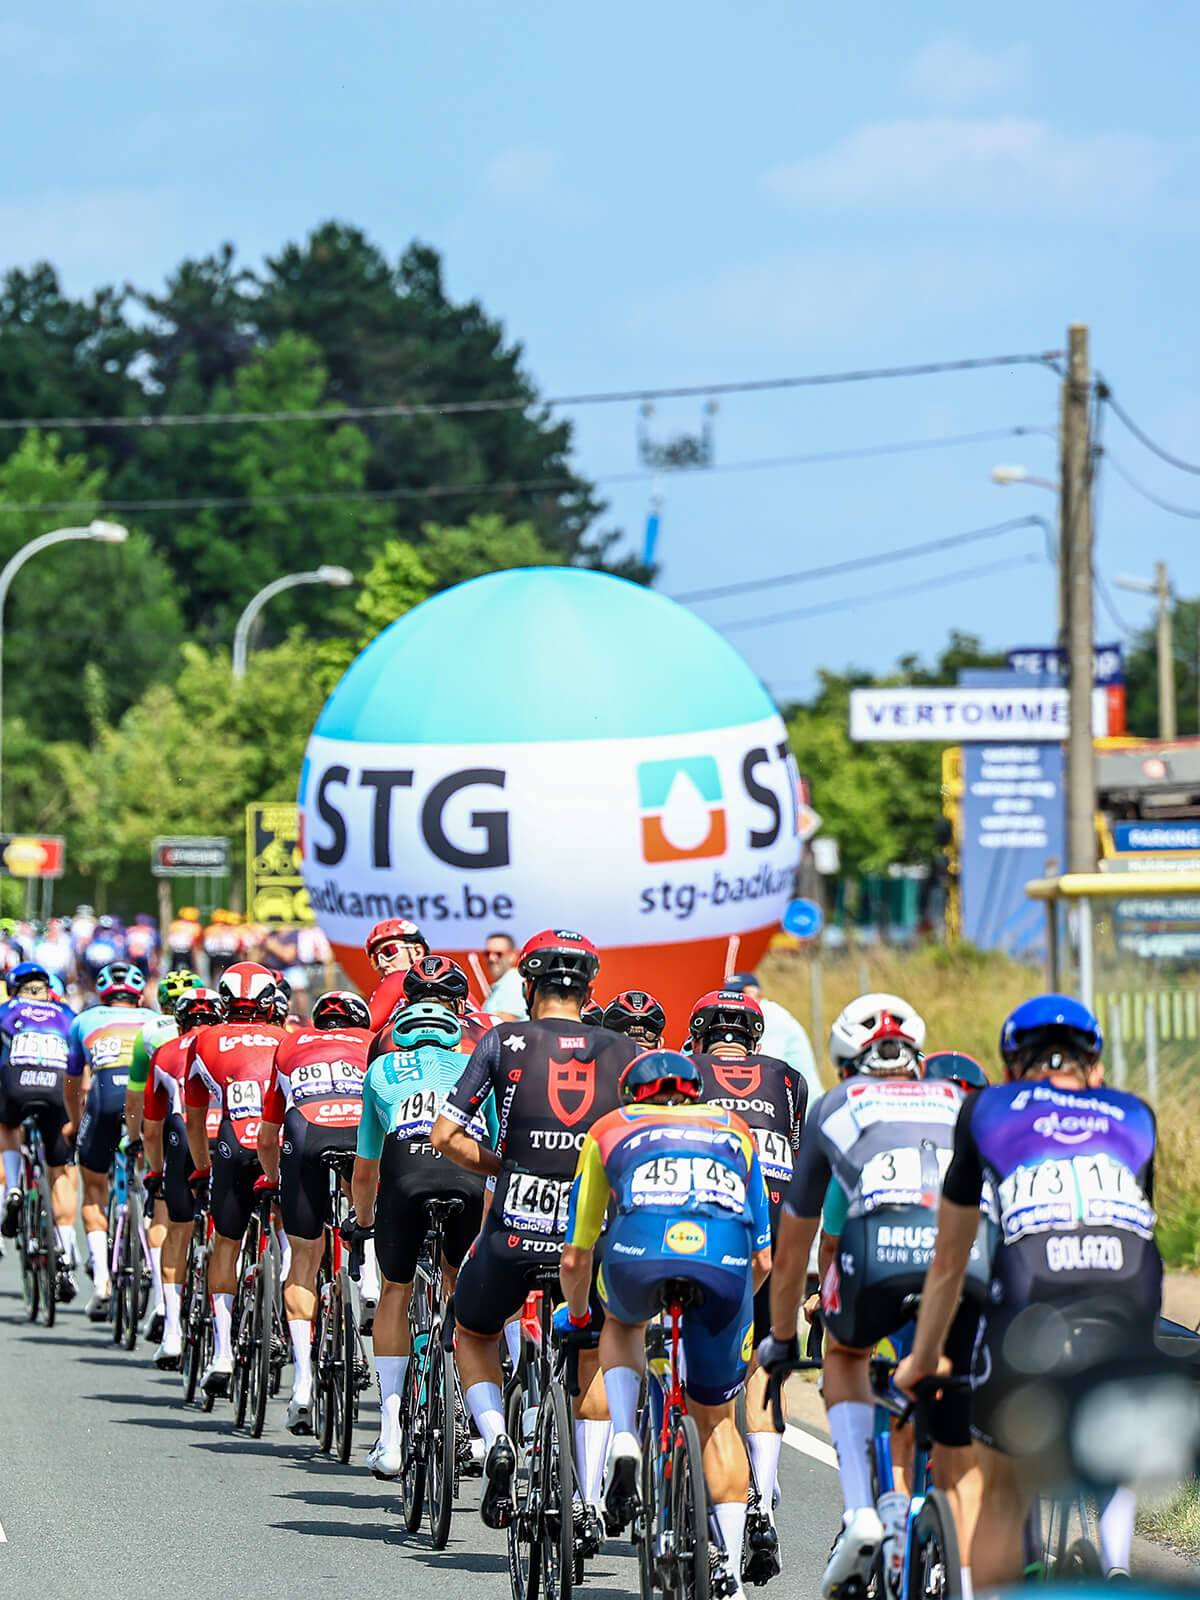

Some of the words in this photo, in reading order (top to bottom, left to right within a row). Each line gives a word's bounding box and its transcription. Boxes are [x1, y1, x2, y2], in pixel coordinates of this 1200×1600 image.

[866, 702, 1067, 726] VERTOMME
[313, 764, 511, 869] STG
[307, 879, 514, 920] adkamers.be
[20, 1070, 58, 1087] GOLAZO
[299, 1064, 322, 1082] 86
[232, 1083, 256, 1105] 84
[401, 1091, 436, 1121] 194
[706, 1097, 776, 1119] TUDOR
[530, 1130, 587, 1151] TUDO
[622, 1127, 743, 1154] TREK
[644, 1158, 679, 1187] 45
[705, 1159, 737, 1191] 45
[880, 1152, 897, 1182] 3
[509, 1175, 555, 1215] 146
[522, 1239, 565, 1253] TUDO
[877, 1226, 939, 1249] BRUS
[876, 1246, 909, 1264] SUN
[1046, 1236, 1124, 1271] GOLAZO
